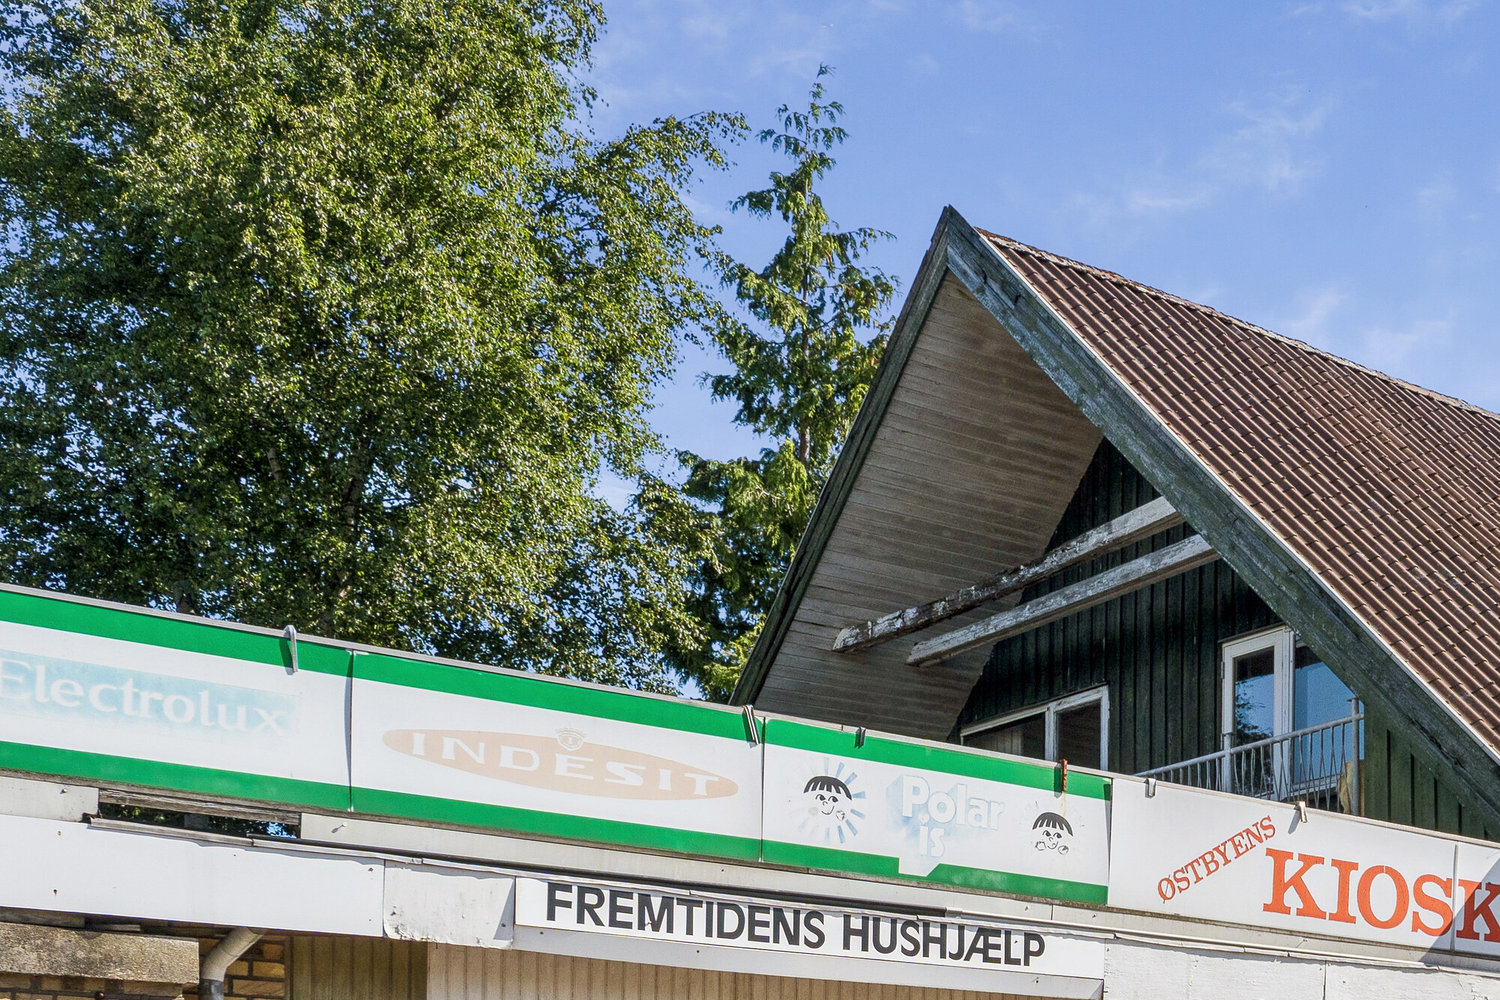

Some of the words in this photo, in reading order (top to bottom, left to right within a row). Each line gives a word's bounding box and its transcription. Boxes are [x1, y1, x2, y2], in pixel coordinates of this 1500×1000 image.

[0, 657, 288, 736] Electrolux
[411, 732, 720, 796] INDESIT
[899, 774, 1005, 831] Polar
[1156, 814, 1277, 905] ØSTBYENS
[546, 881, 825, 950] FREMTIDENS
[842, 912, 1047, 967] HUSHJÆLP
